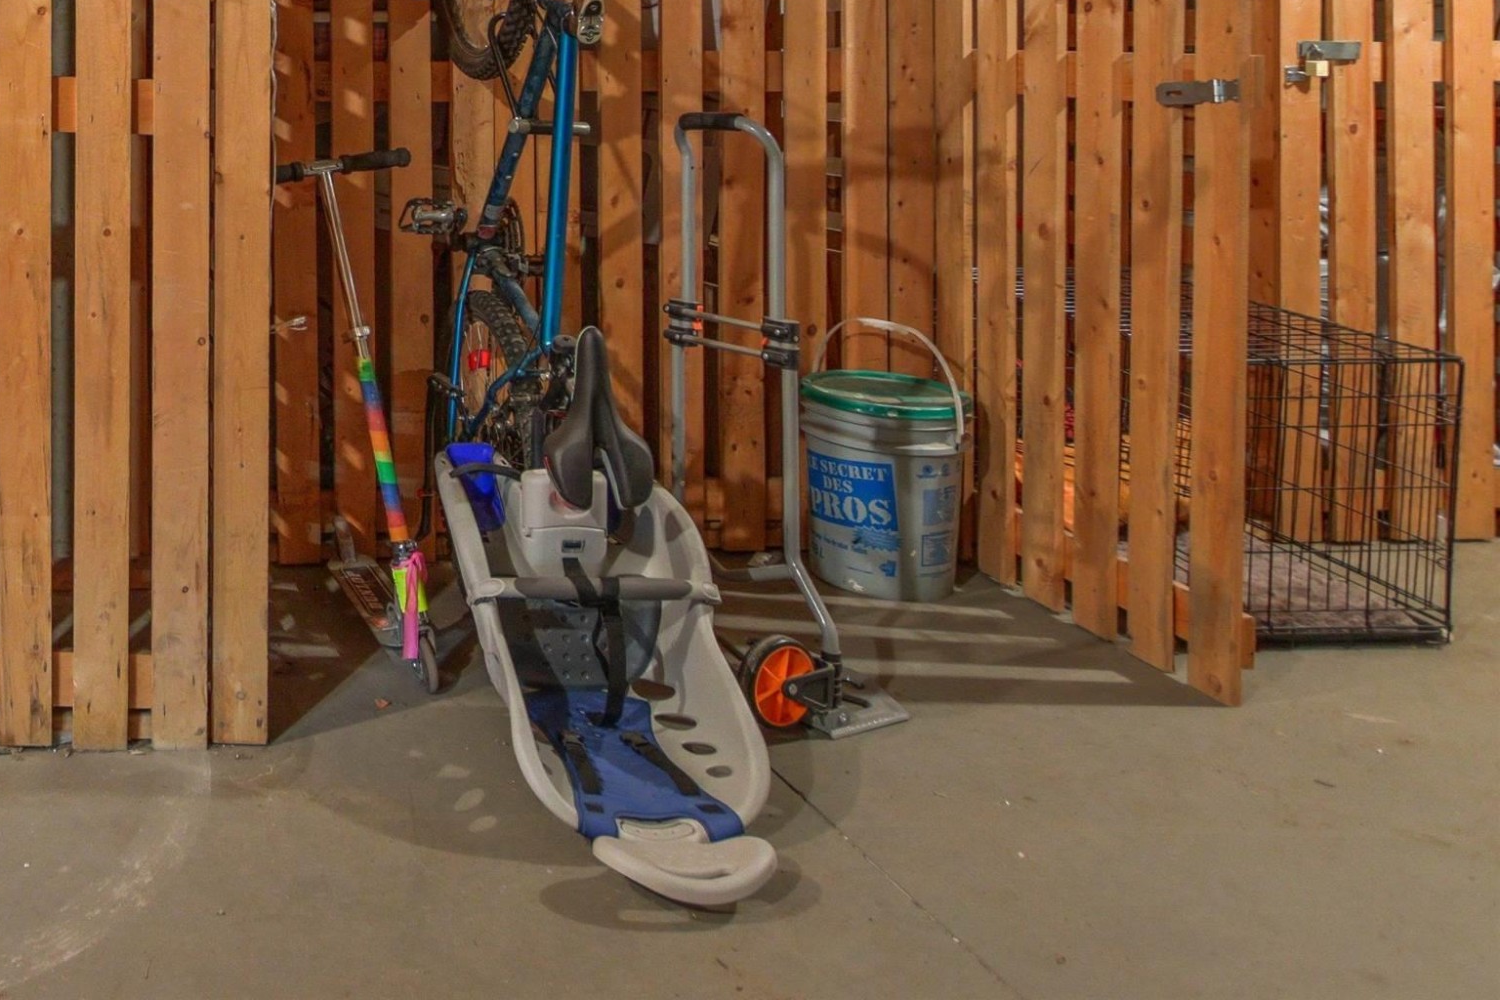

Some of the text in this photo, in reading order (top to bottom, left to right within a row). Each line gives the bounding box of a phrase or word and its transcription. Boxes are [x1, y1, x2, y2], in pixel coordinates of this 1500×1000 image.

[819, 460, 887, 482] SECRET
[823, 475, 853, 494] DES
[810, 485, 892, 526] PROS
